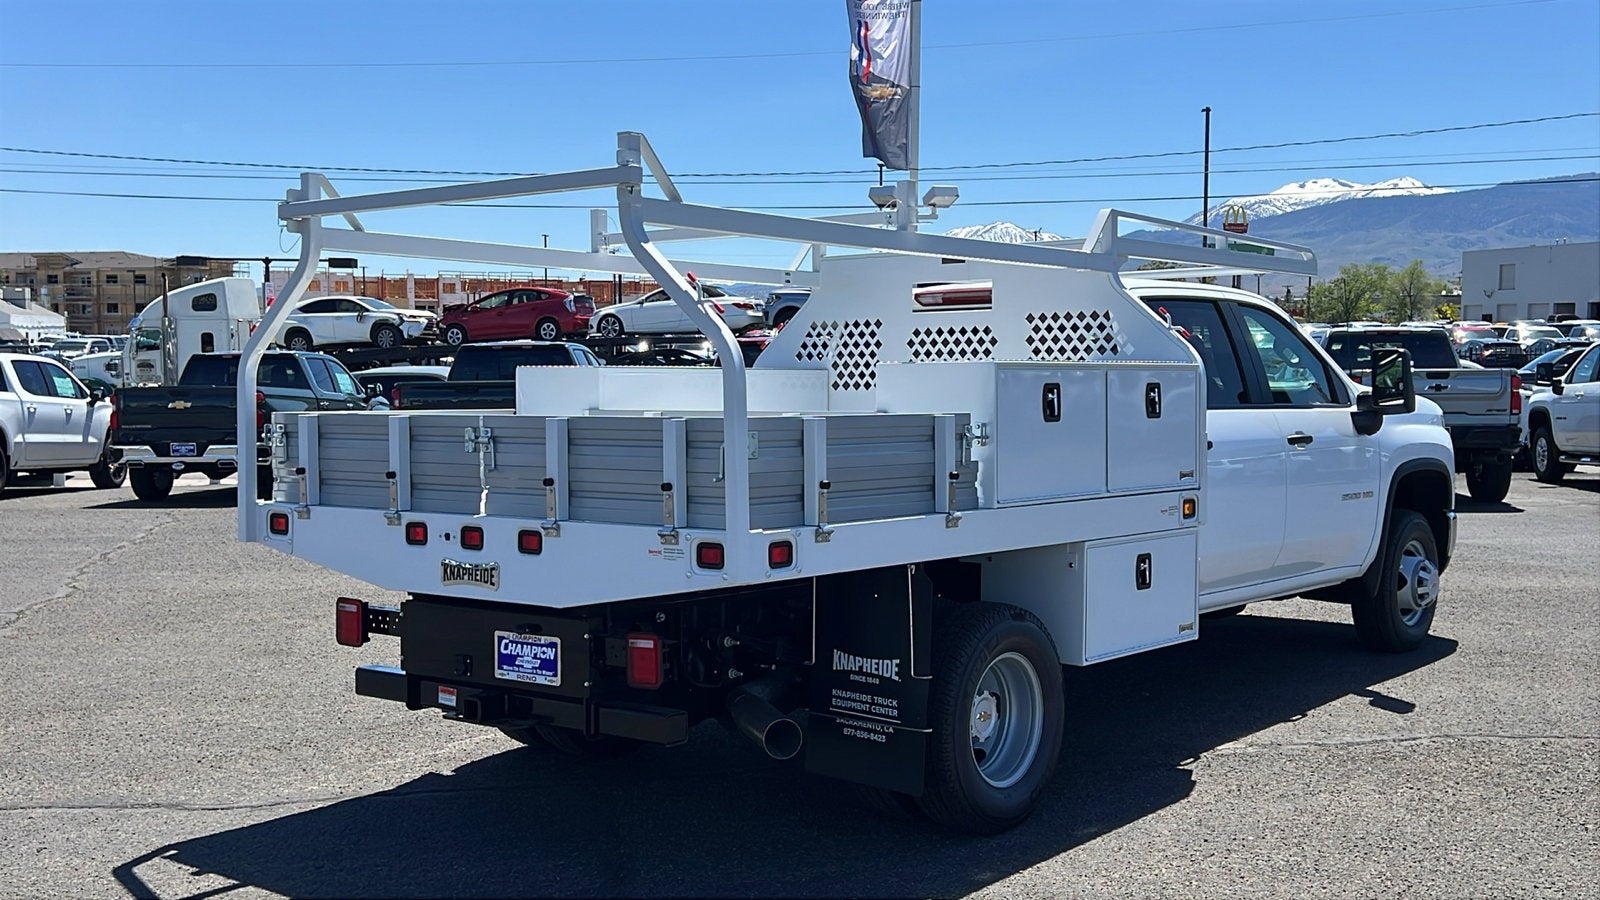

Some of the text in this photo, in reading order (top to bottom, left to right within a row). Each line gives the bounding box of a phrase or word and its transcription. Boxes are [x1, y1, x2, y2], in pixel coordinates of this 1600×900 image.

[443, 563, 496, 587] KNAPHEIDE
[512, 634, 542, 643] CHAMPION
[500, 639, 555, 660] CHAMPION
[833, 649, 900, 681] KNAPHEIDE
[517, 674, 537, 682] RENO
[850, 674, 866, 682] SINCE
[832, 689, 898, 707] KNAPHEIDE TRUCK
[832, 698, 898, 717] EQUIPMENT CENTER
